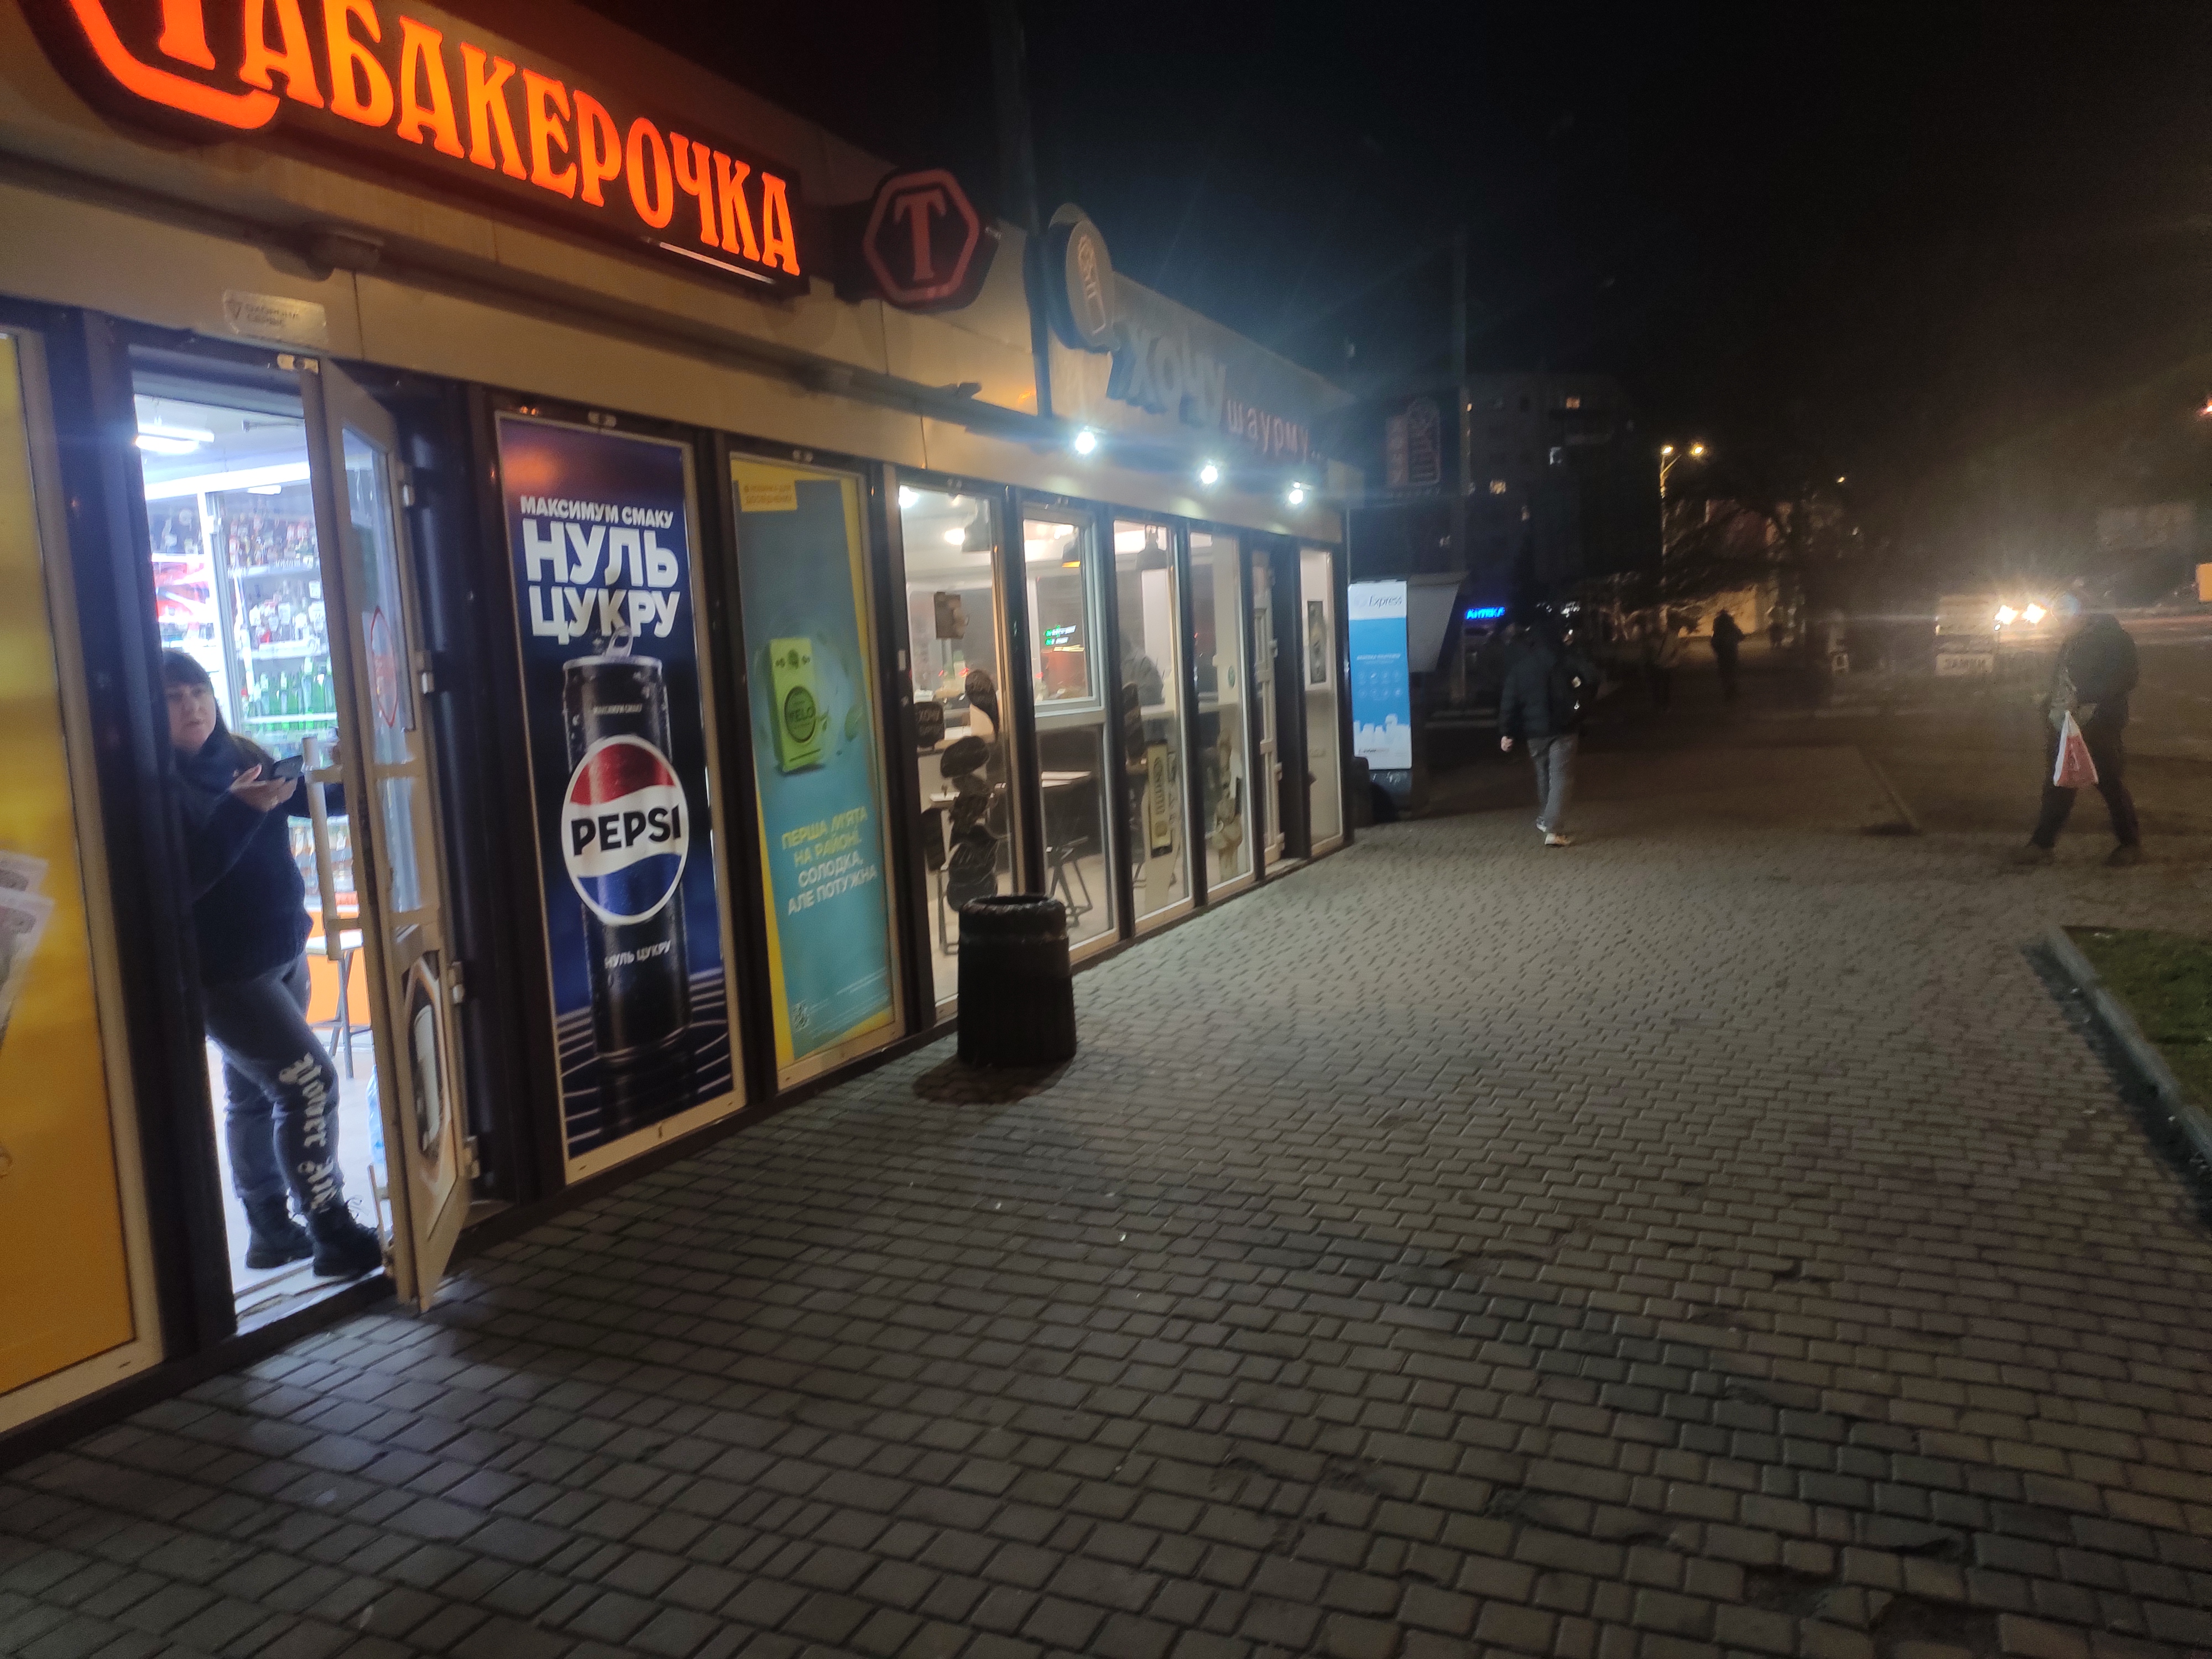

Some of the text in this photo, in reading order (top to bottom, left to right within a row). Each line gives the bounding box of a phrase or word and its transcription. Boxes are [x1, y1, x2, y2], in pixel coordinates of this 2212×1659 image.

[520, 494, 674, 529] МАКСИМУМ СМАКУ
[523, 518, 679, 588] НУЛЬ
[528, 585, 680, 645] ЦУКРУ
[571, 804, 681, 856] PEPSI
[781, 820, 828, 850] ПЕРША
[794, 847, 811, 867] НА
[788, 865, 877, 915] АЛЕ ПОТУЖНА
